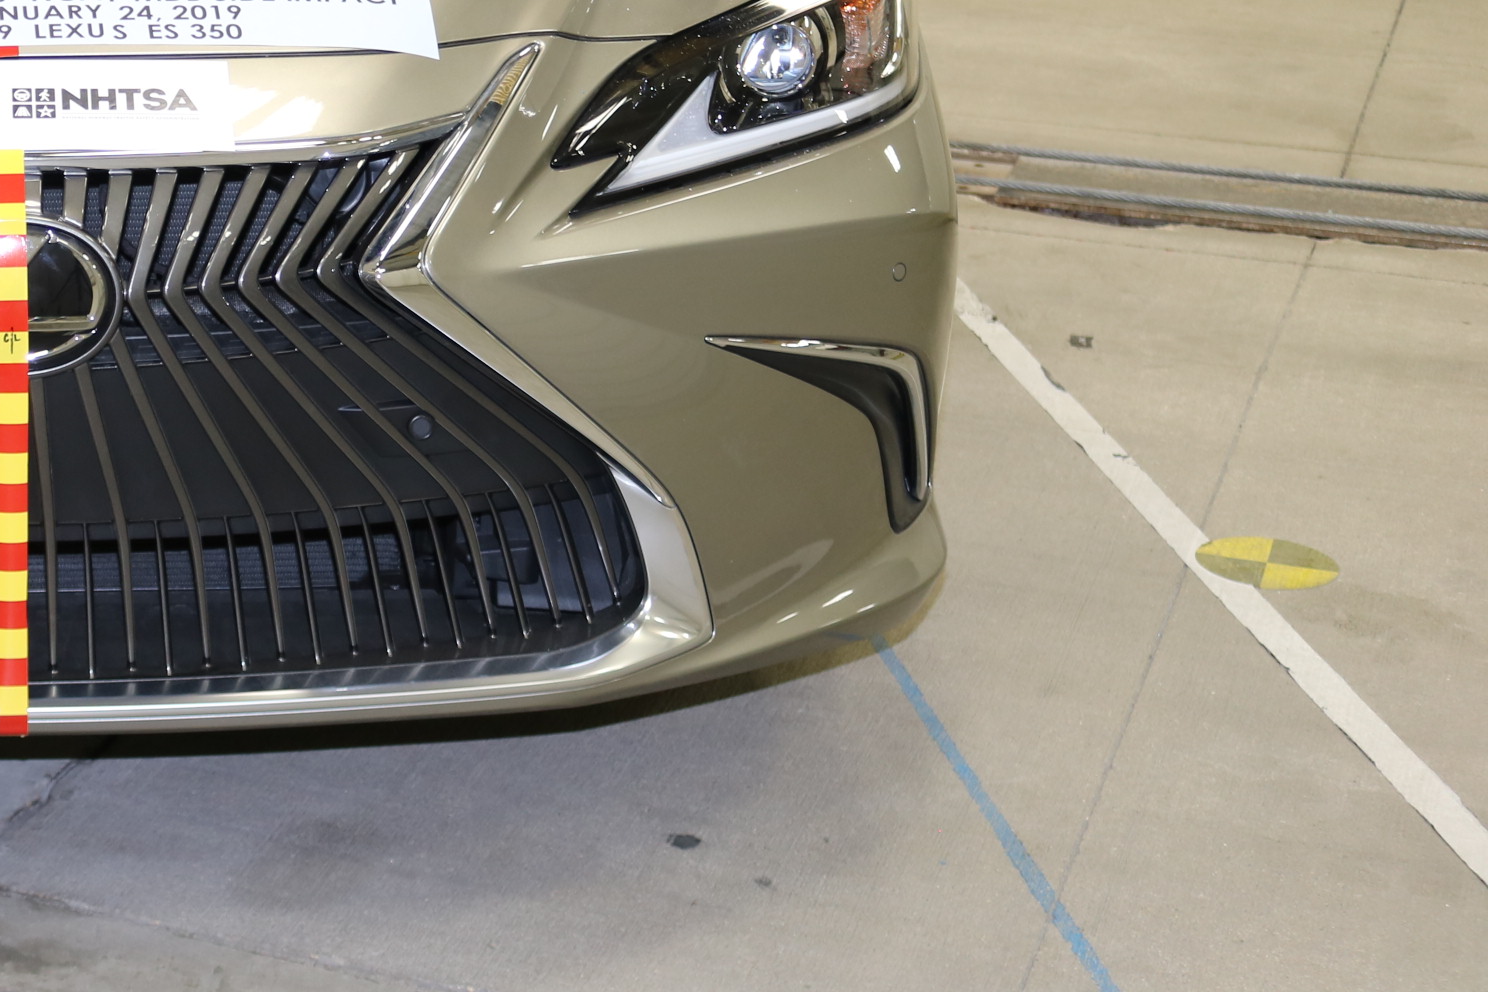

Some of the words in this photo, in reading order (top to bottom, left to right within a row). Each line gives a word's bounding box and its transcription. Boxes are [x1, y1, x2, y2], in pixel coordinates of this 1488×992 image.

[119, 5, 161, 22] 24,
[172, 4, 242, 21] 2019
[34, 22, 128, 40] LEXUS
[147, 23, 179, 40] ES
[190, 23, 243, 40] 350
[61, 87, 199, 111] NHTSA
